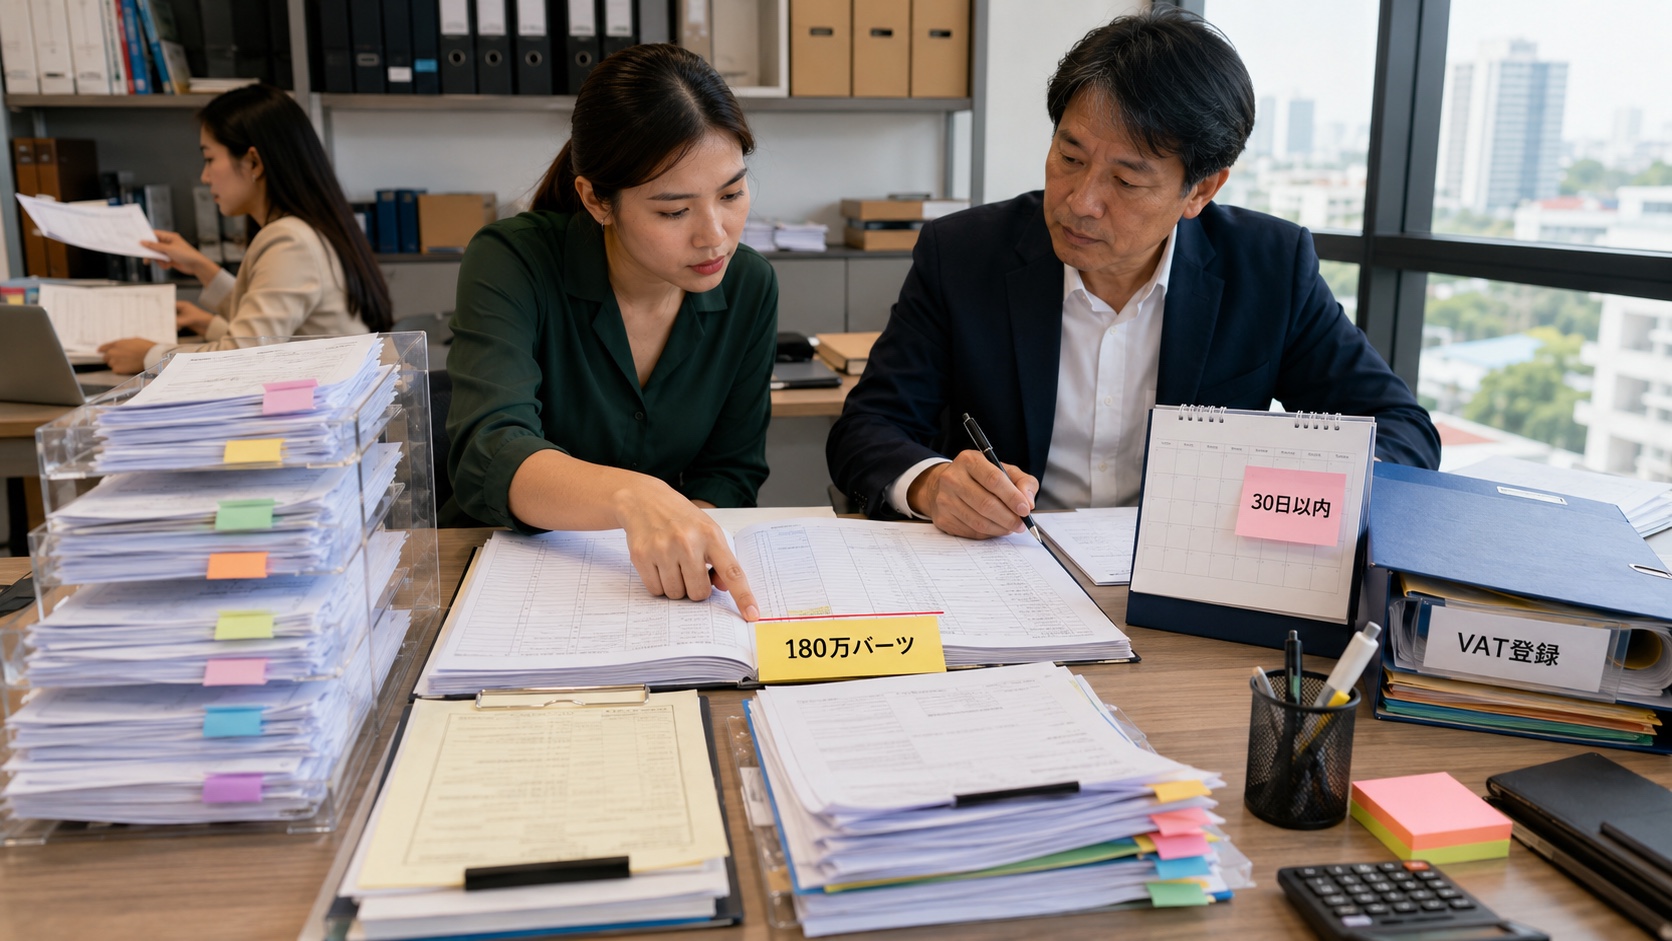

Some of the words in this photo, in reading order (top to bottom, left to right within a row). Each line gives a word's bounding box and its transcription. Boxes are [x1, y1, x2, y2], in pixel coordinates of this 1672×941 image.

[1251, 493, 1331, 518] 30日以内
[785, 636, 914, 659] 180万バーツ
[1457, 632, 1561, 668] VAT登録
